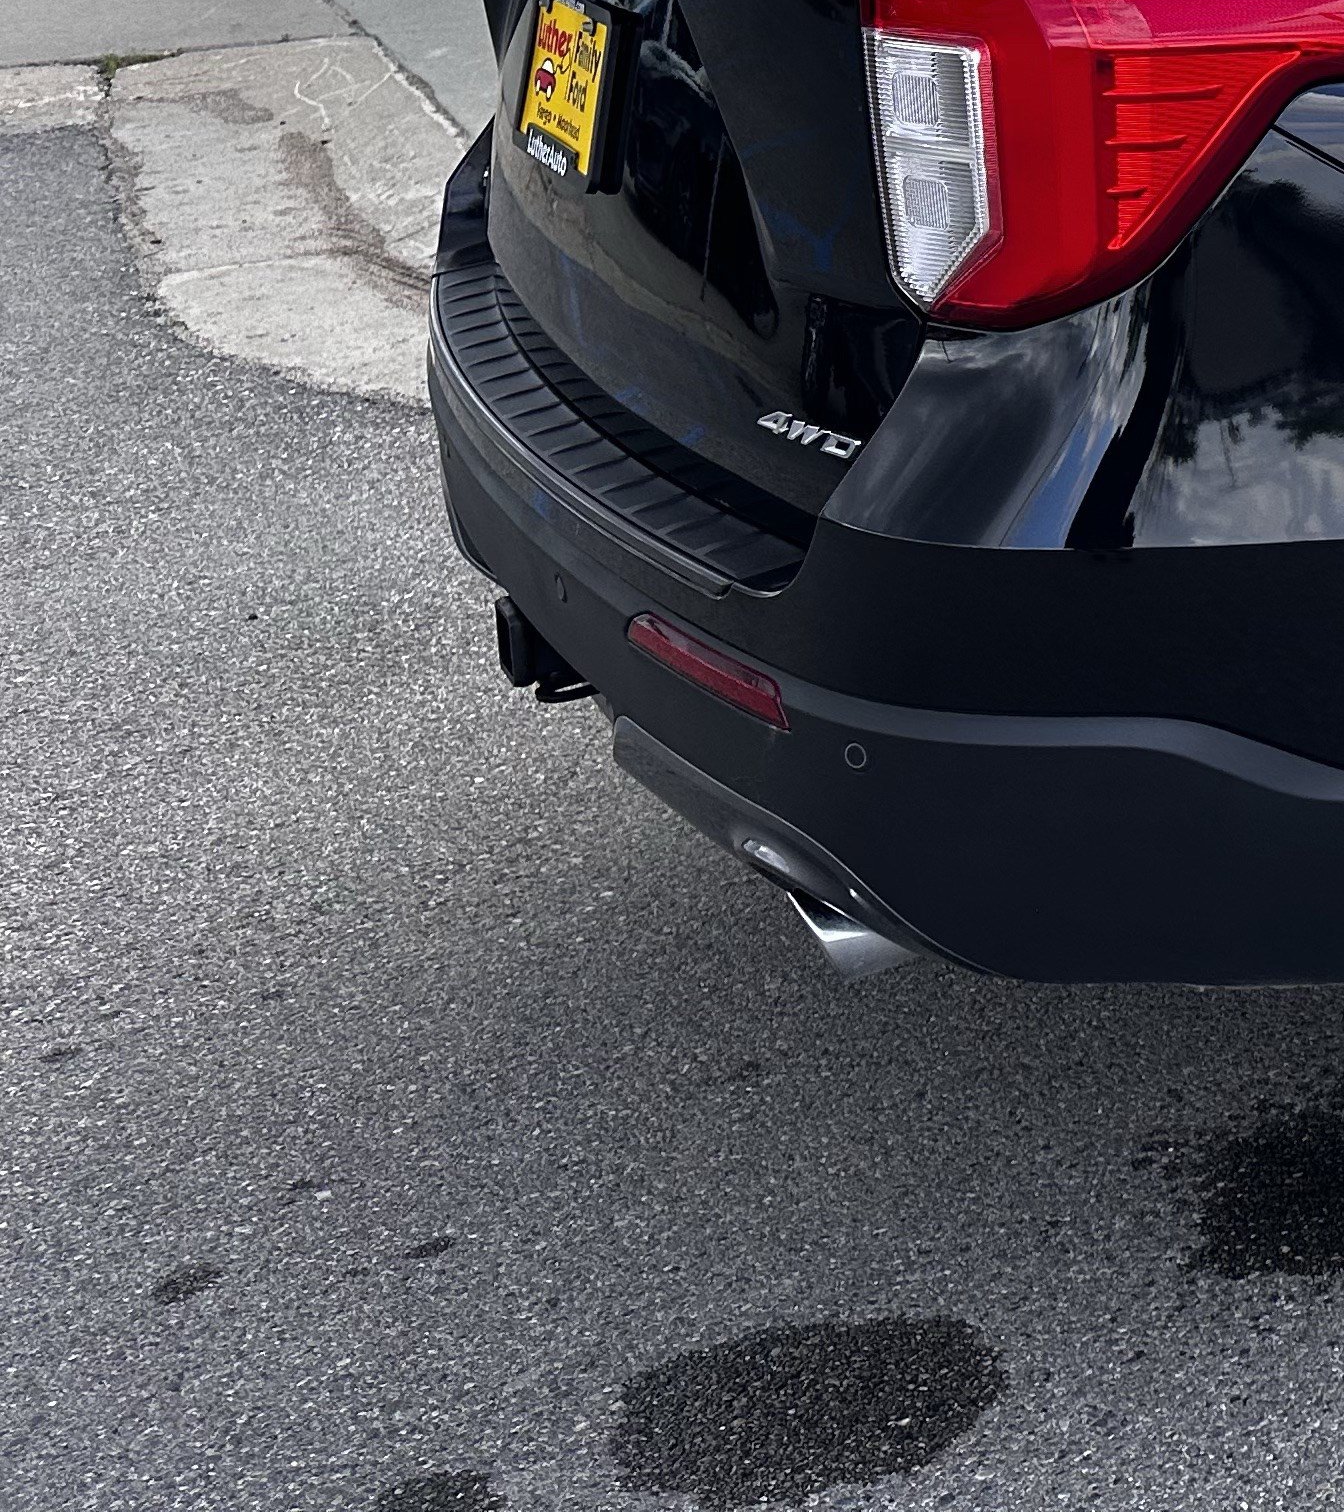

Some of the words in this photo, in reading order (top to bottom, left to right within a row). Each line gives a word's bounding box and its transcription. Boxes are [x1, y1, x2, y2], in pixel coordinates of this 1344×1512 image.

[537, 13, 573, 57] Luther
[573, 30, 602, 83] Family
[566, 70, 588, 113] Ford
[757, 410, 862, 459] 4WD
